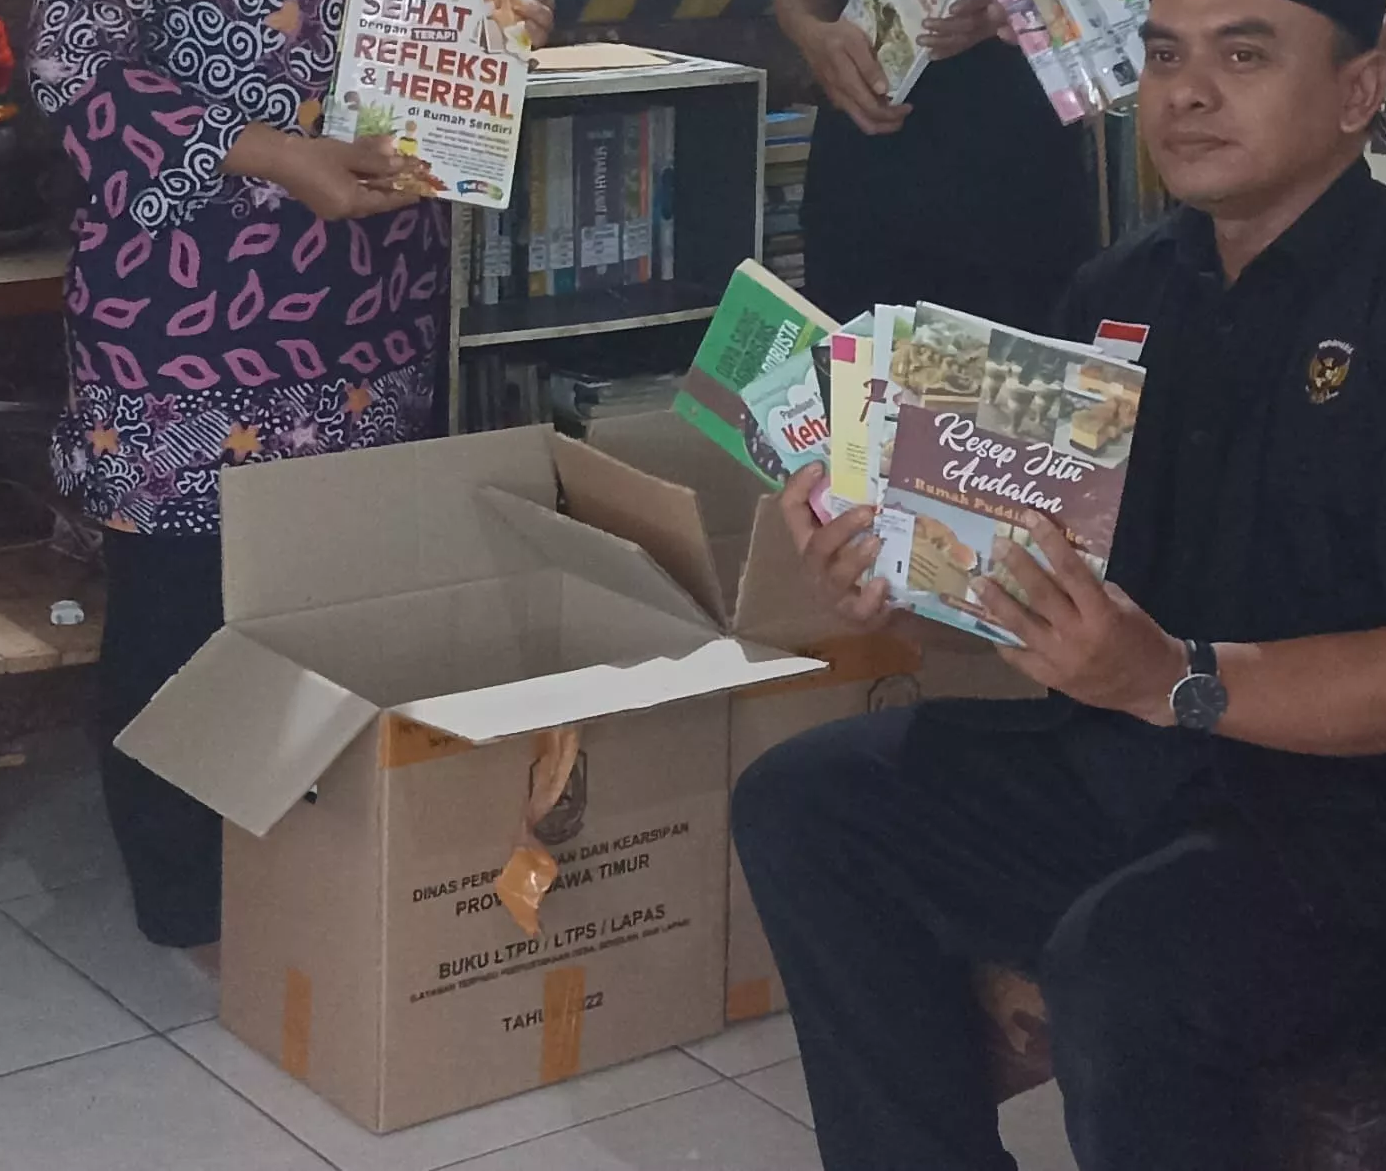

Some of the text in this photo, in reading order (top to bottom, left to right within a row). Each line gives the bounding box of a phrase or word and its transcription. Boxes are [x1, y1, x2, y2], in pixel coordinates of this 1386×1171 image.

[359, 18, 456, 42] Dengan TERAPI
[353, 34, 508, 86] REFLEKSI
[361, 67, 514, 120] & HERBAL
[408, 106, 512, 135] di Rumah Sendiri
[934, 412, 1095, 482] Resep Jitu
[915, 477, 969, 505] Rumah
[942, 456, 1063, 514] Andalan
[412, 880, 458, 903] DINAS
[580, 842, 609, 860] DAN
[613, 822, 689, 850] KEARSIPAN
[599, 854, 649, 878] TIMUR
[438, 951, 489, 980] BUKU
[494, 938, 539, 964] LTPD
[554, 923, 597, 949] LTPS
[611, 905, 665, 934] LAPAS
